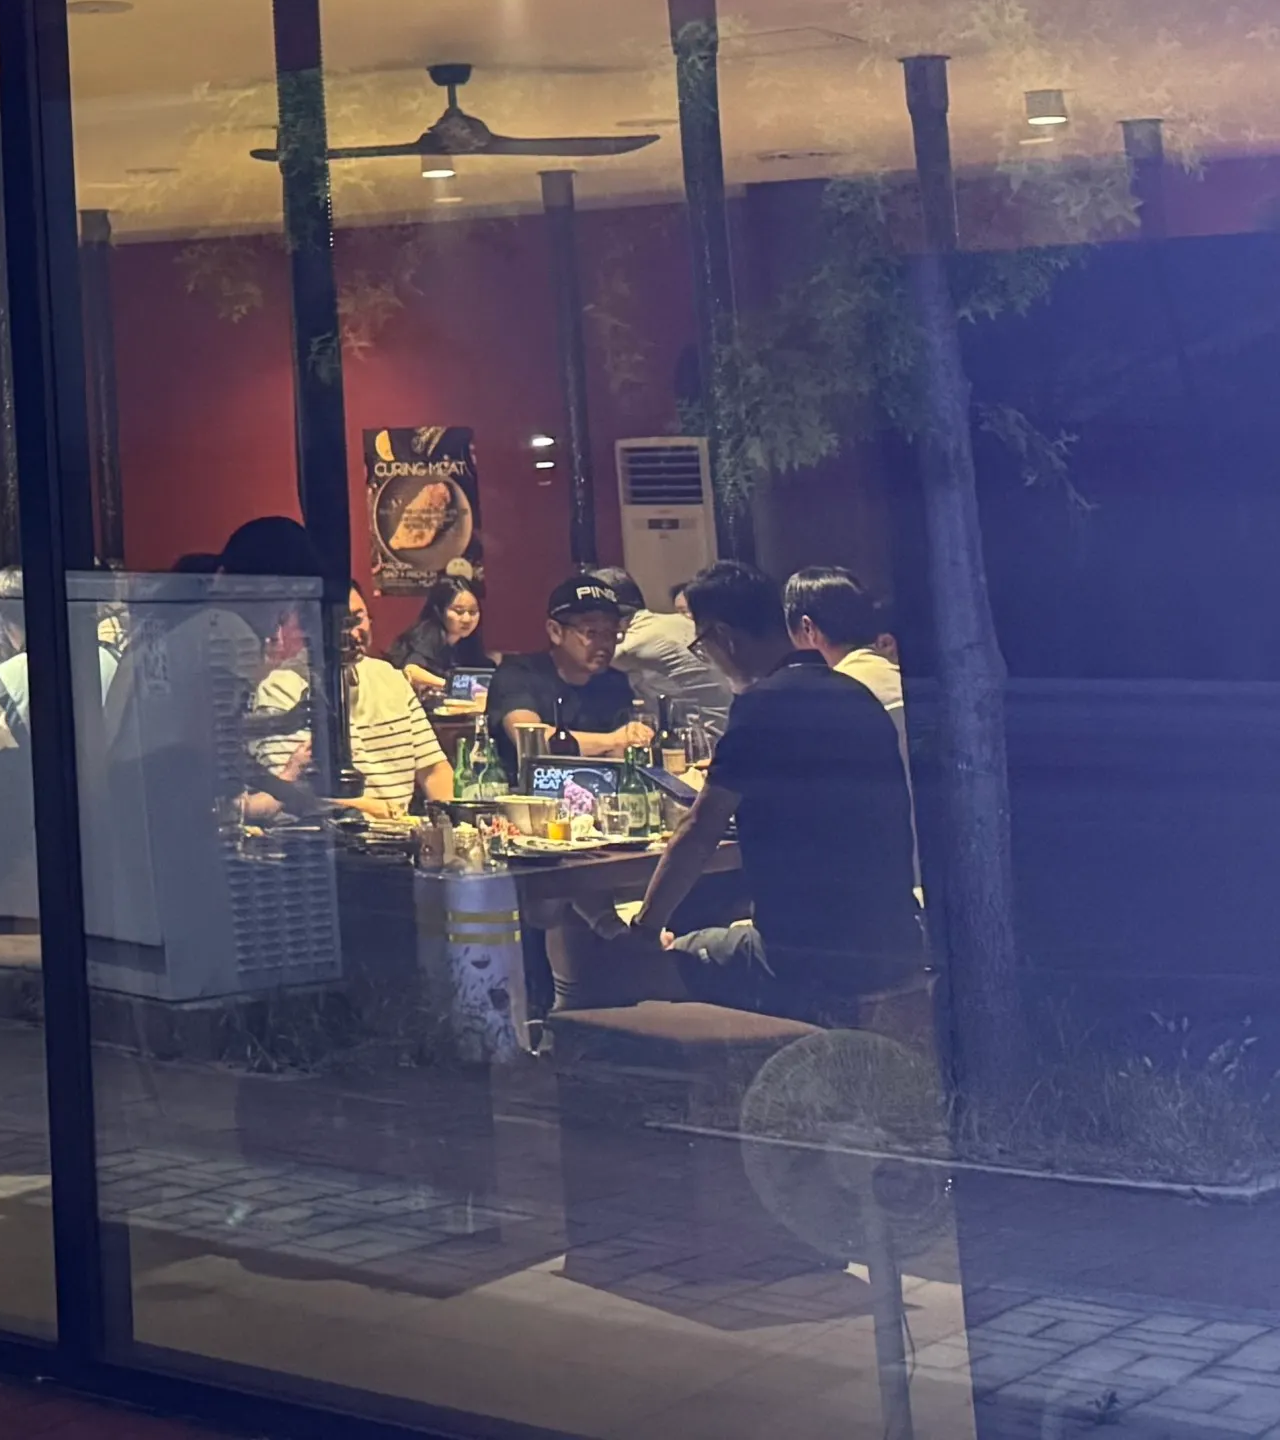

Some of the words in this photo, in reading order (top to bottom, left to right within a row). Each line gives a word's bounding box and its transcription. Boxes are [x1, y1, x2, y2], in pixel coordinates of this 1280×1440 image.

[374, 462, 426, 477] CURING
[428, 462, 467, 476] MEAT
[534, 768, 573, 779] CURING
[533, 778, 561, 789] MEAT
